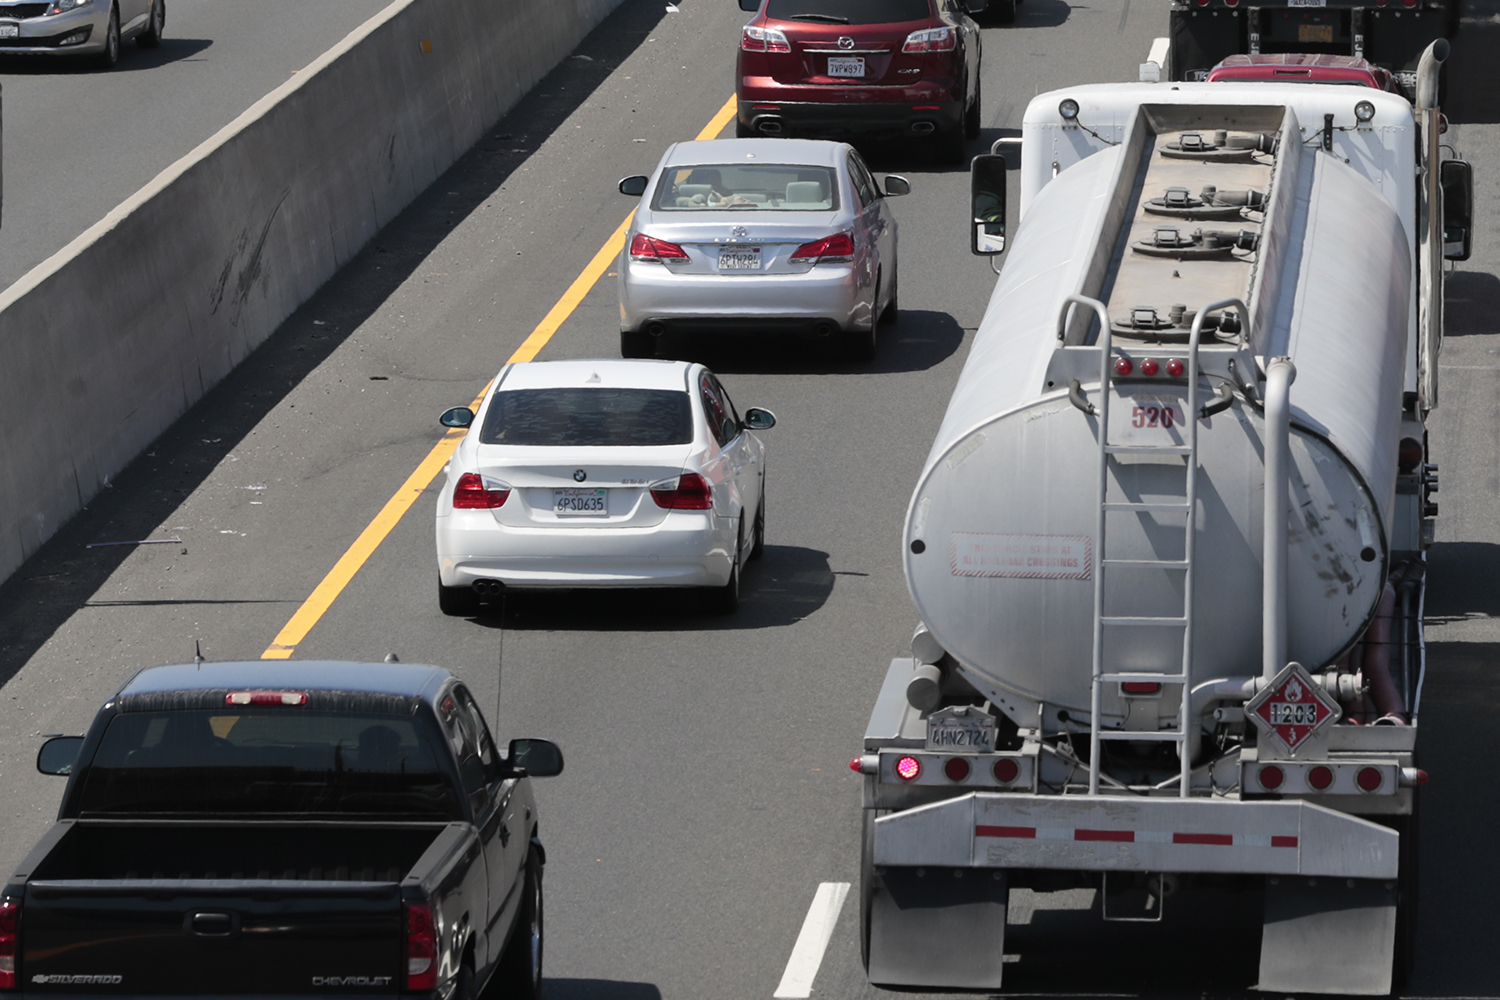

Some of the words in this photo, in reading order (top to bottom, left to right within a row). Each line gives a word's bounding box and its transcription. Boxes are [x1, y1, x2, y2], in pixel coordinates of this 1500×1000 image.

[830, 64, 863, 74] 7VPW897
[1132, 407, 1173, 428] 520
[558, 498, 604, 510] 6PSD635
[1061, 546, 1071, 555] AT
[1027, 557, 1078, 568] CROSSINGS
[1272, 704, 1316, 723] 1203
[932, 728, 989, 746] 4HN2724
[48, 975, 122, 983] SILVERADO
[312, 976, 392, 985] CHEVROLET
